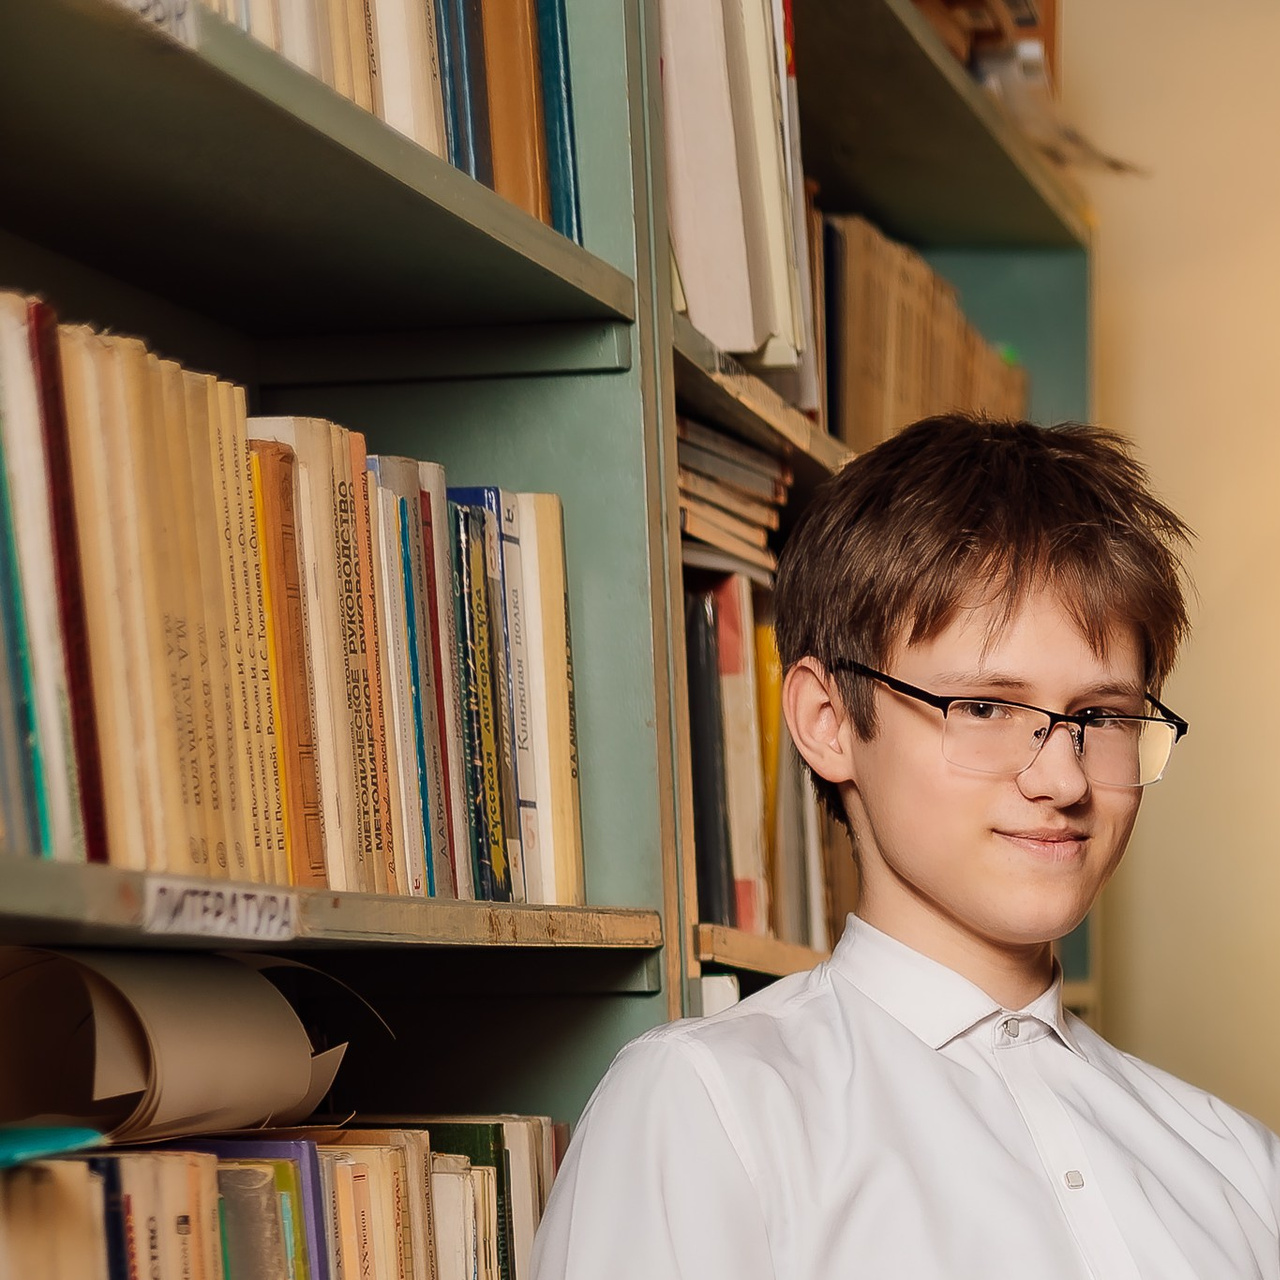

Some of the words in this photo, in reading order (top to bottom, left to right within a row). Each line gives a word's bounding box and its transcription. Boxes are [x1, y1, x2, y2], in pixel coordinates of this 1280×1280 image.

[338, 480, 358, 655] РУКОВОДСТВО
[475, 588, 491, 734] литература
[511, 588, 522, 646] полка
[239, 681, 250, 730] Роман
[252, 685, 262, 734] Роман
[264, 686, 275, 735] Роман
[458, 643, 472, 773] ЛИТЕРАТУРЫ
[515, 658, 529, 752] Книжная
[351, 669, 372, 854] МЕТОДИЧЕСКОЕ
[362, 668, 383, 852] МЕТОДИЧЕСКОЕ
[466, 785, 475, 827] МИР
[484, 751, 500, 848] Русская
[153, 886, 291, 935] ЛИТЕРАТУРА
